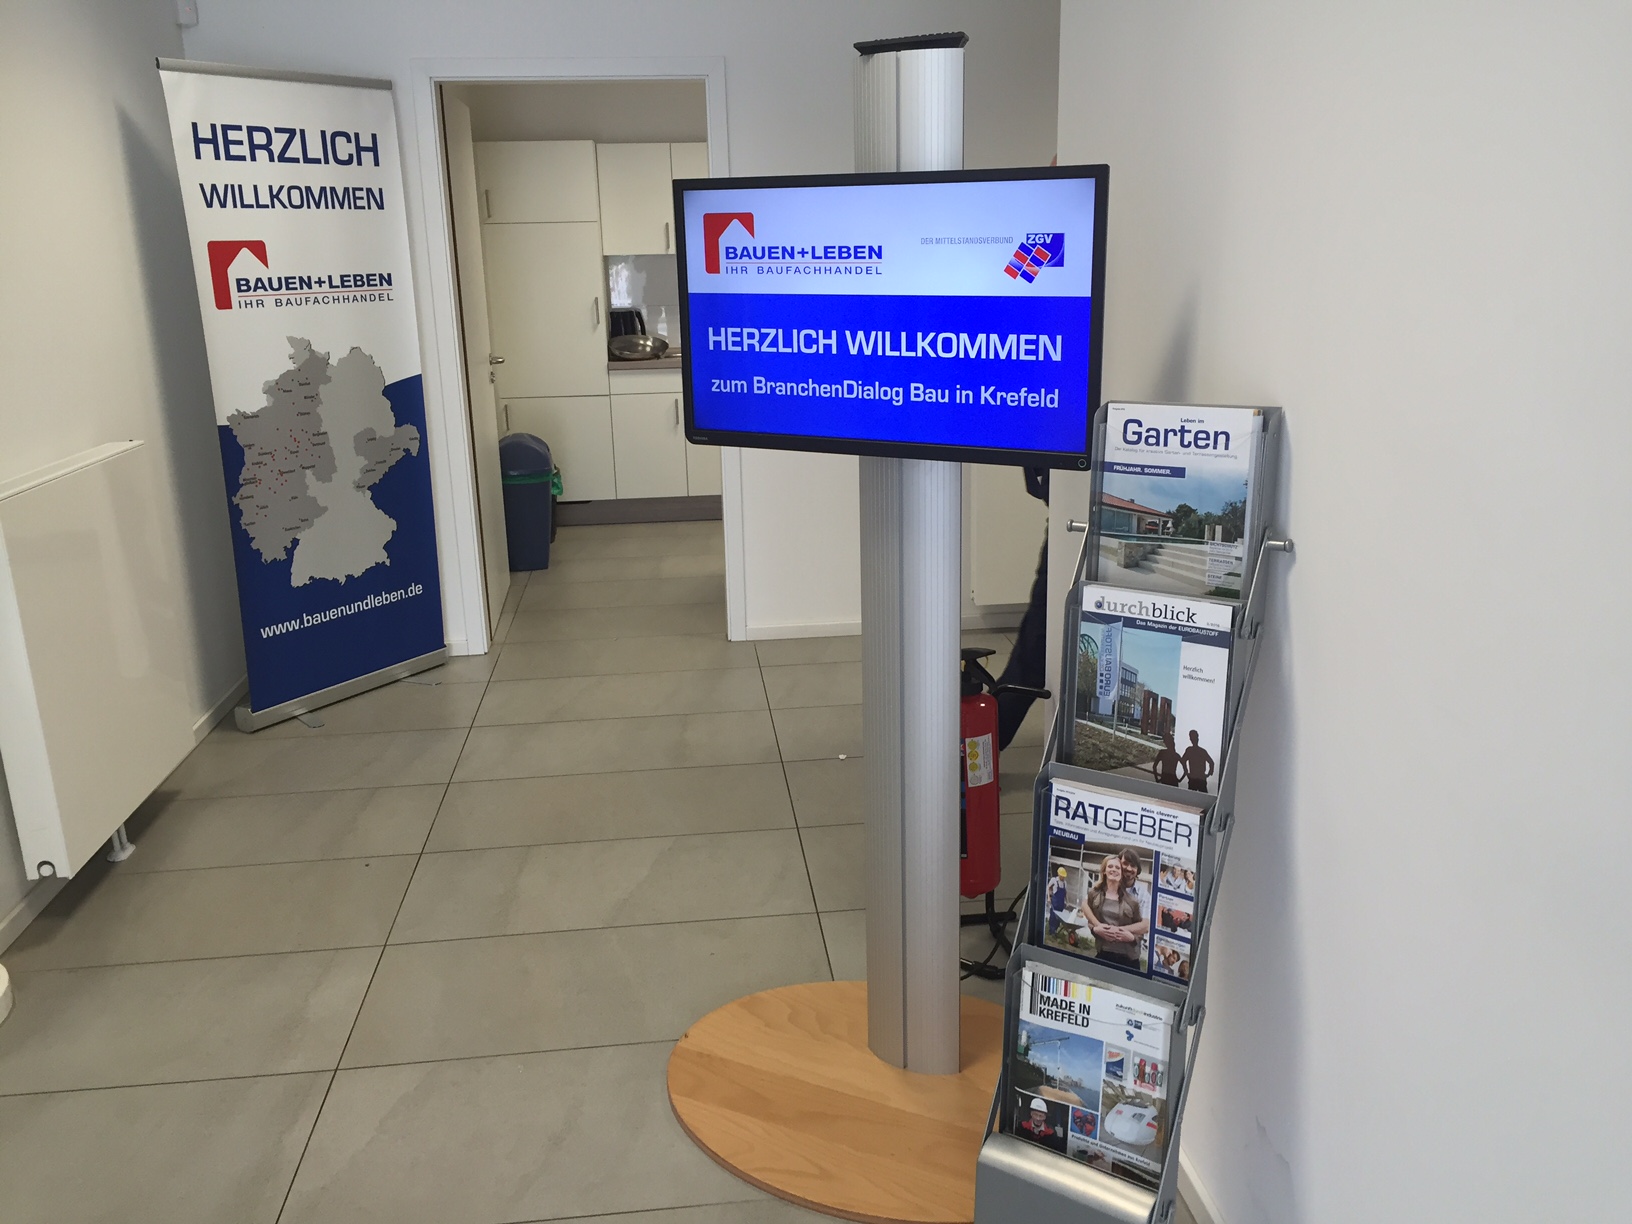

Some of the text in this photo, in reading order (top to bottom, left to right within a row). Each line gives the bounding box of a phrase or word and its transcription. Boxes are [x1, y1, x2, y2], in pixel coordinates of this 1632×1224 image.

[191, 122, 380, 167] HERZLICH
[199, 183, 385, 211] WILLKOMMEN
[920, 237, 934, 245] DER
[1027, 233, 1053, 244] ZGV
[725, 244, 883, 260] BAUEN+LEBEN
[725, 265, 882, 275] IHR BAUFACHHANDEL
[235, 273, 393, 293] BAUEN+LEBEN
[238, 293, 394, 310] IHR BAUFACHHANDEL
[708, 327, 1063, 362] HERZLICH WILLKOMMEN
[711, 376, 1059, 408] zum BranchenDialog Bau in Krefeld
[1122, 419, 1231, 451] Garten
[260, 583, 423, 639] www.bauenundleben.de
[1094, 595, 1198, 624] durchblick
[1136, 619, 1146, 627] Das
[1147, 621, 1168, 630] Magazin
[1178, 625, 1220, 638] EUROBAUSTOFF
[1182, 673, 1216, 684] willkommen!
[1183, 665, 1204, 674] Herzlich
[1054, 795, 1192, 847] RATGEBER
[1141, 806, 1179, 820] Mein cleverer
[1053, 828, 1079, 841] NEUBAU
[1039, 994, 1091, 1016] MADE IN
[1038, 1006, 1090, 1029] KREFELD
